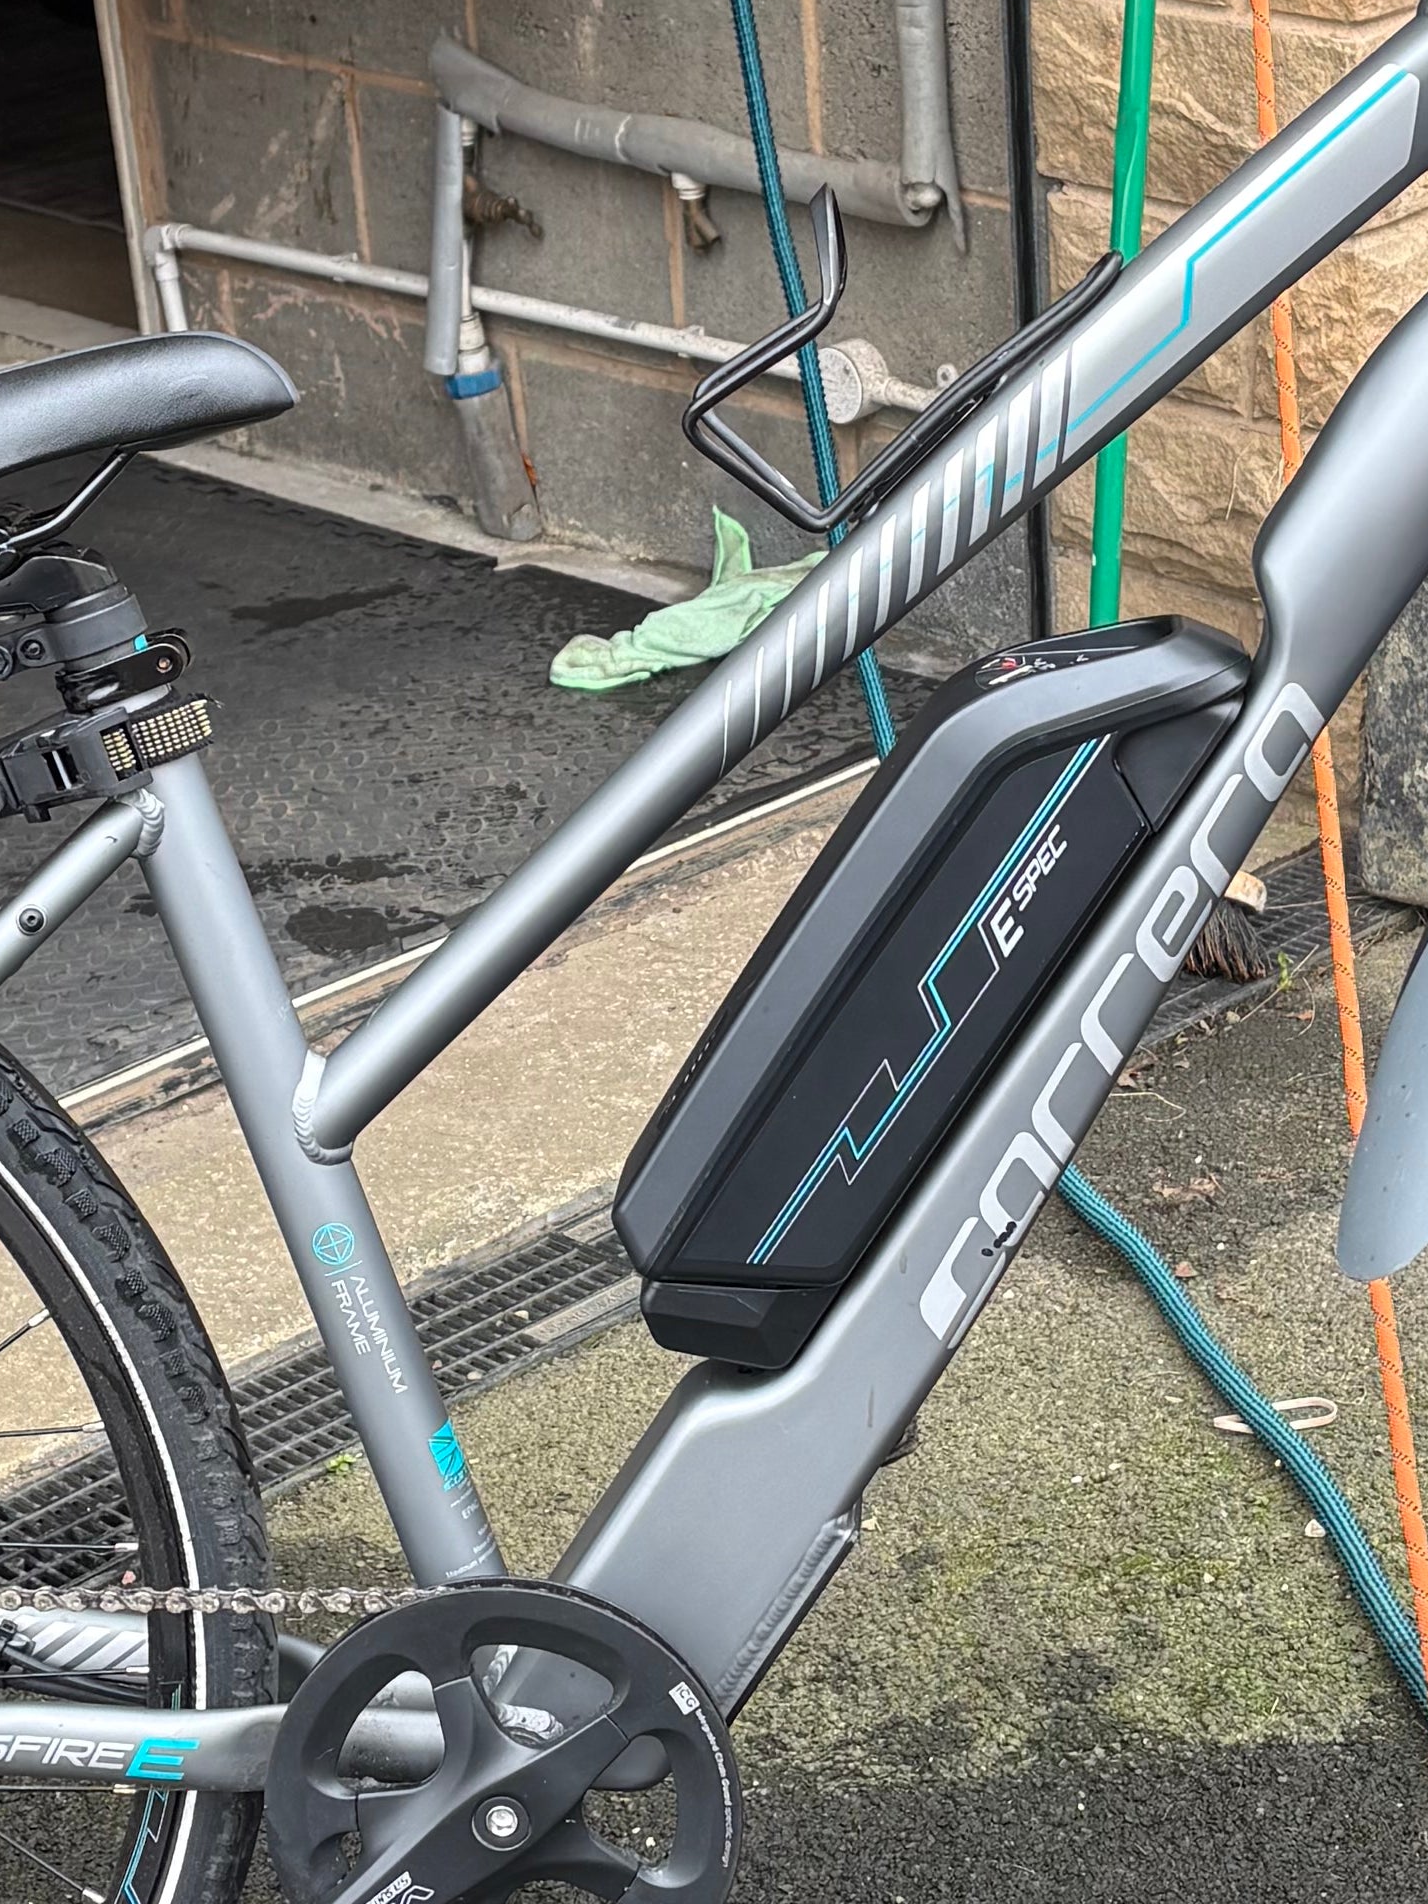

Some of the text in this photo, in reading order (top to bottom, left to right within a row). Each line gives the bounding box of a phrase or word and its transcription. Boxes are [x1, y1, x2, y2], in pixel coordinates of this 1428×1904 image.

[989, 824, 1068, 958] E SPEC
[919, 681, 1326, 1349] carrera
[332, 1279, 372, 1356] FRAME
[350, 1276, 409, 1395] ALUMINIUM
[675, 1683, 697, 1709] ICG
[125, 1737, 201, 1781] E
